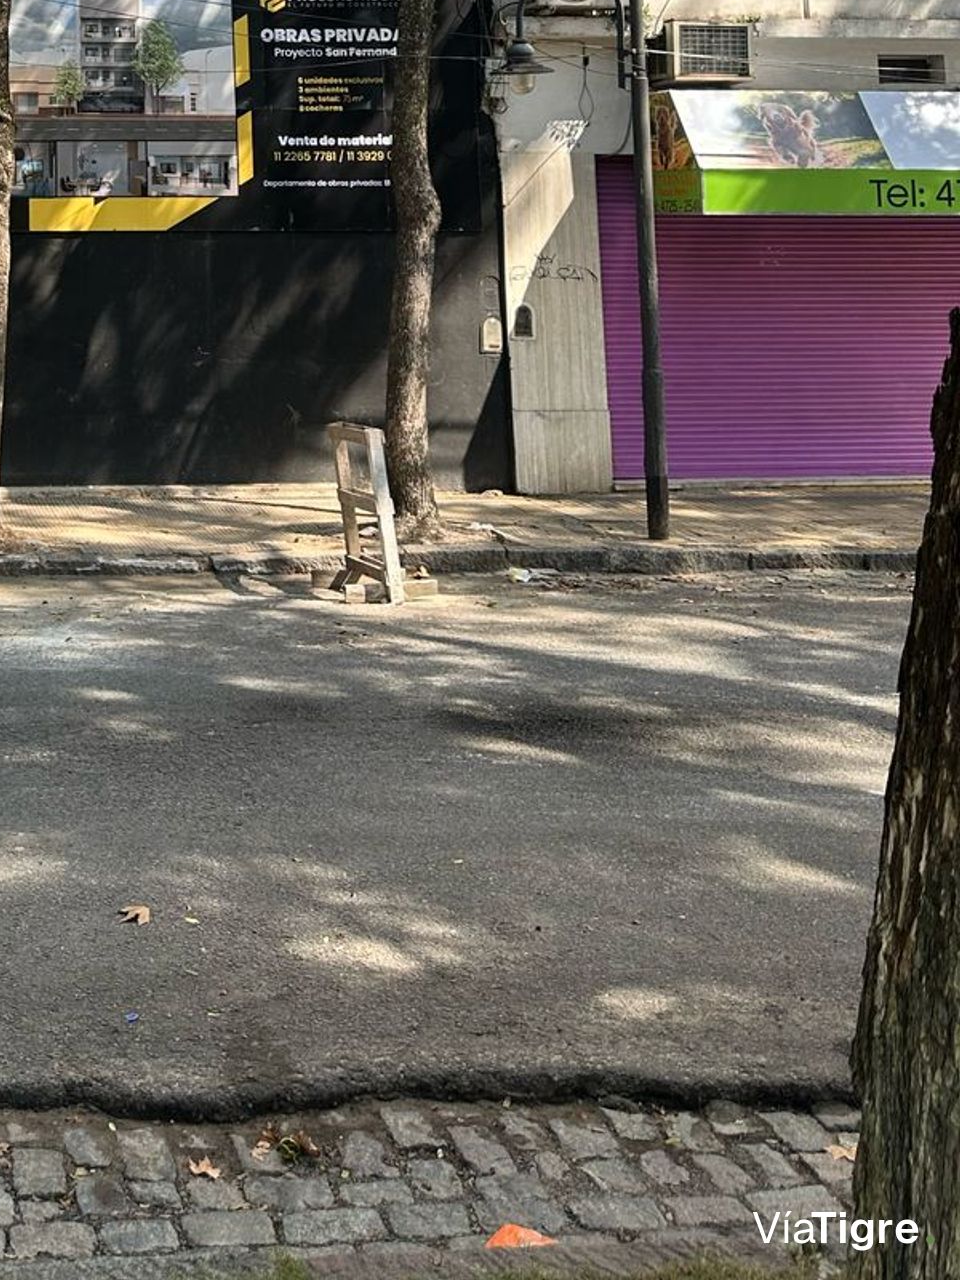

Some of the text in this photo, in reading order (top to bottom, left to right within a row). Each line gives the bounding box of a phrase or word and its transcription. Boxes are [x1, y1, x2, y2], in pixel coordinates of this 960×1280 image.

[260, 28, 322, 43] OBRAS
[274, 47, 323, 60] Proyecto
[325, 47, 347, 57] San
[304, 76, 343, 84] unidades
[278, 135, 318, 146] Venta
[319, 135, 335, 146] de
[273, 151, 281, 161] 11
[313, 151, 337, 161] 7781
[346, 151, 355, 161] 11
[356, 151, 385, 161] 3929
[263, 179, 316, 188] Departamento
[317, 179, 328, 187] de
[328, 179, 349, 187] obras
[868, 179, 960, 208] Tel: 4
